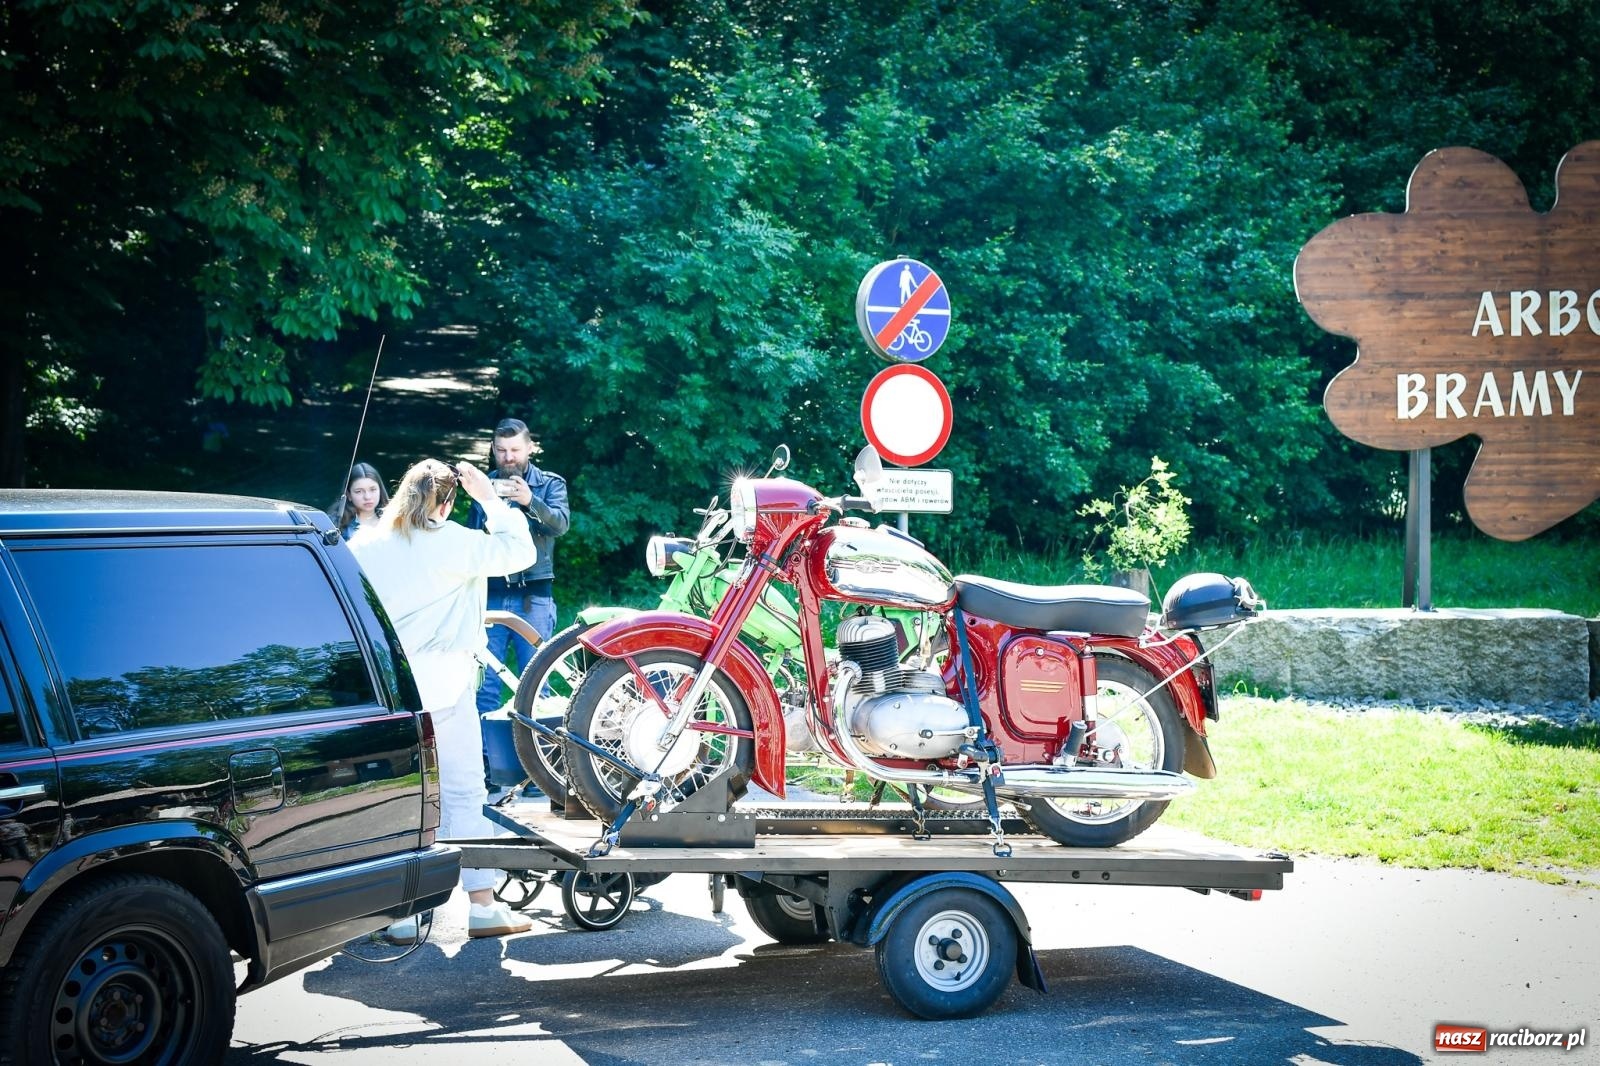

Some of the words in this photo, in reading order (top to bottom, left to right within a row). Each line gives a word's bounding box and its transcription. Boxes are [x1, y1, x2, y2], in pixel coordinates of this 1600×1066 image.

[1397, 370, 1583, 420] BRAMY
[889, 477, 901, 485] Nie
[902, 478, 927, 487] dotyczy
